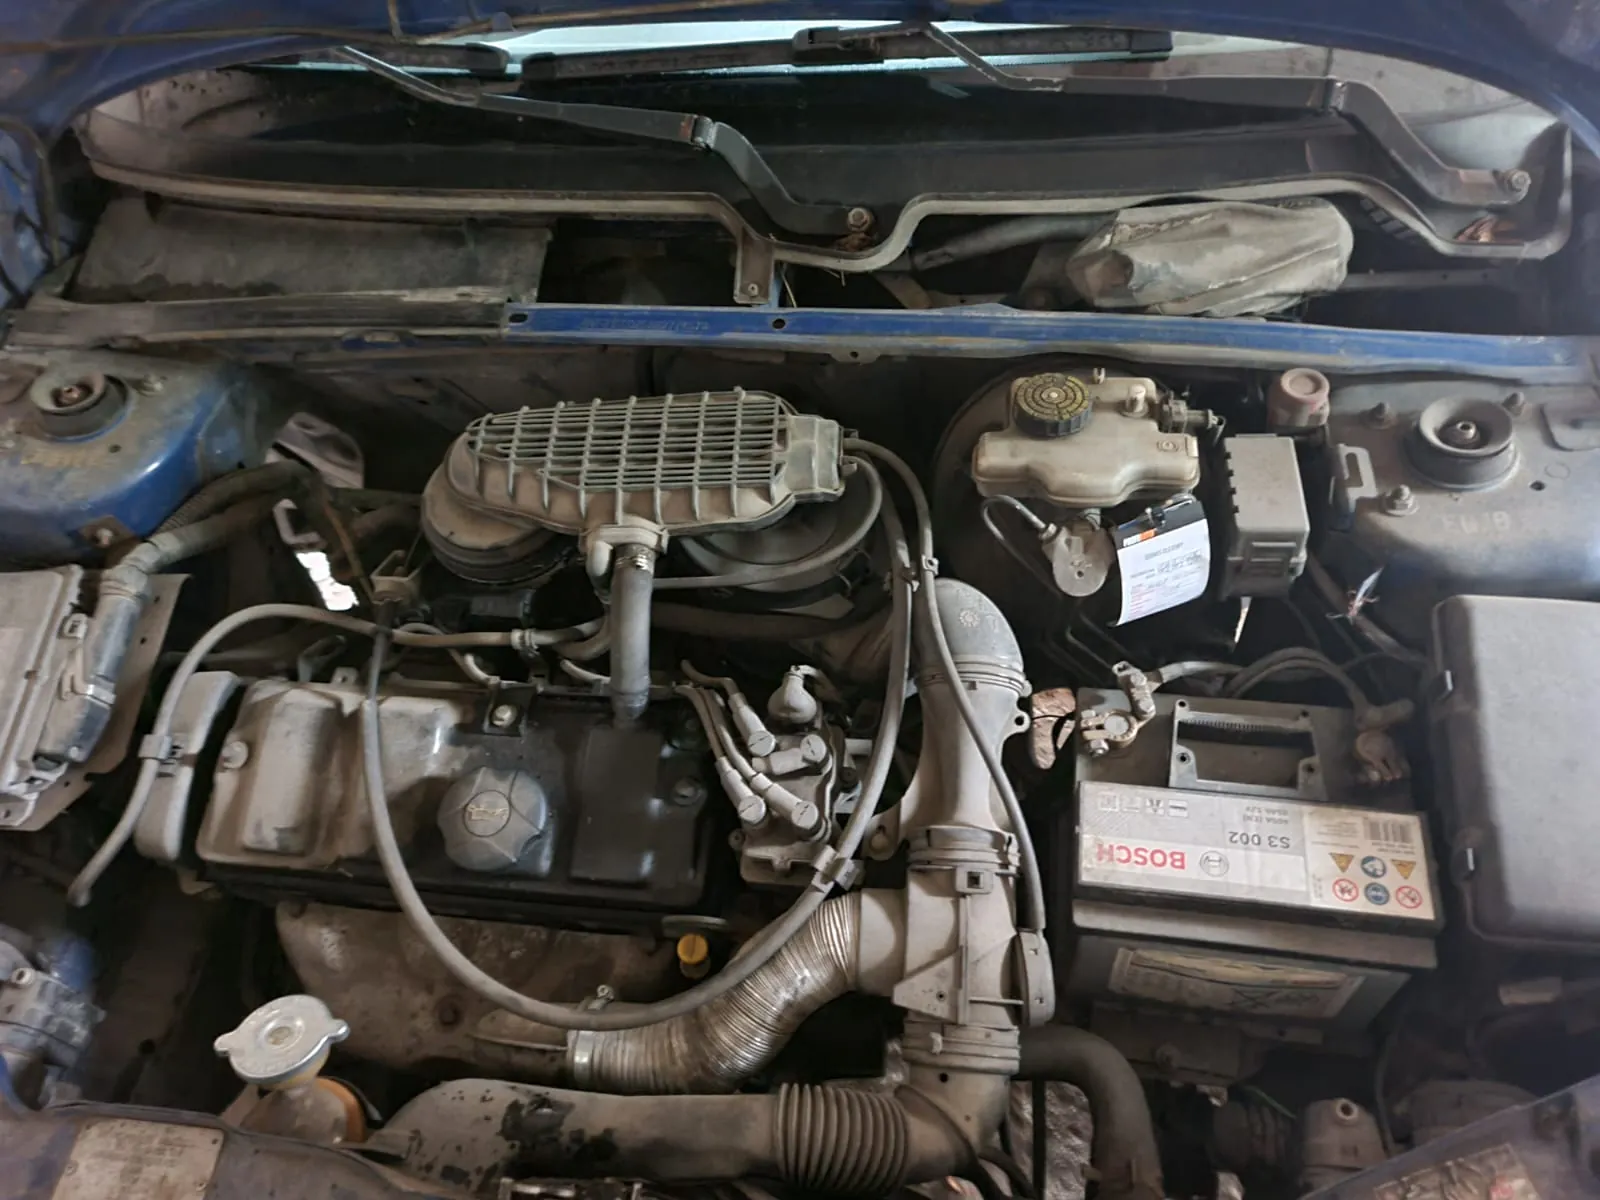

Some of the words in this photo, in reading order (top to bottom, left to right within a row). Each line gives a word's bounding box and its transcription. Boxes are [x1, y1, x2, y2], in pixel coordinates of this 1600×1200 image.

[1228, 831, 1262, 846] 002
[1268, 835, 1291, 849] S3
[1096, 843, 1186, 870] BOSCH
